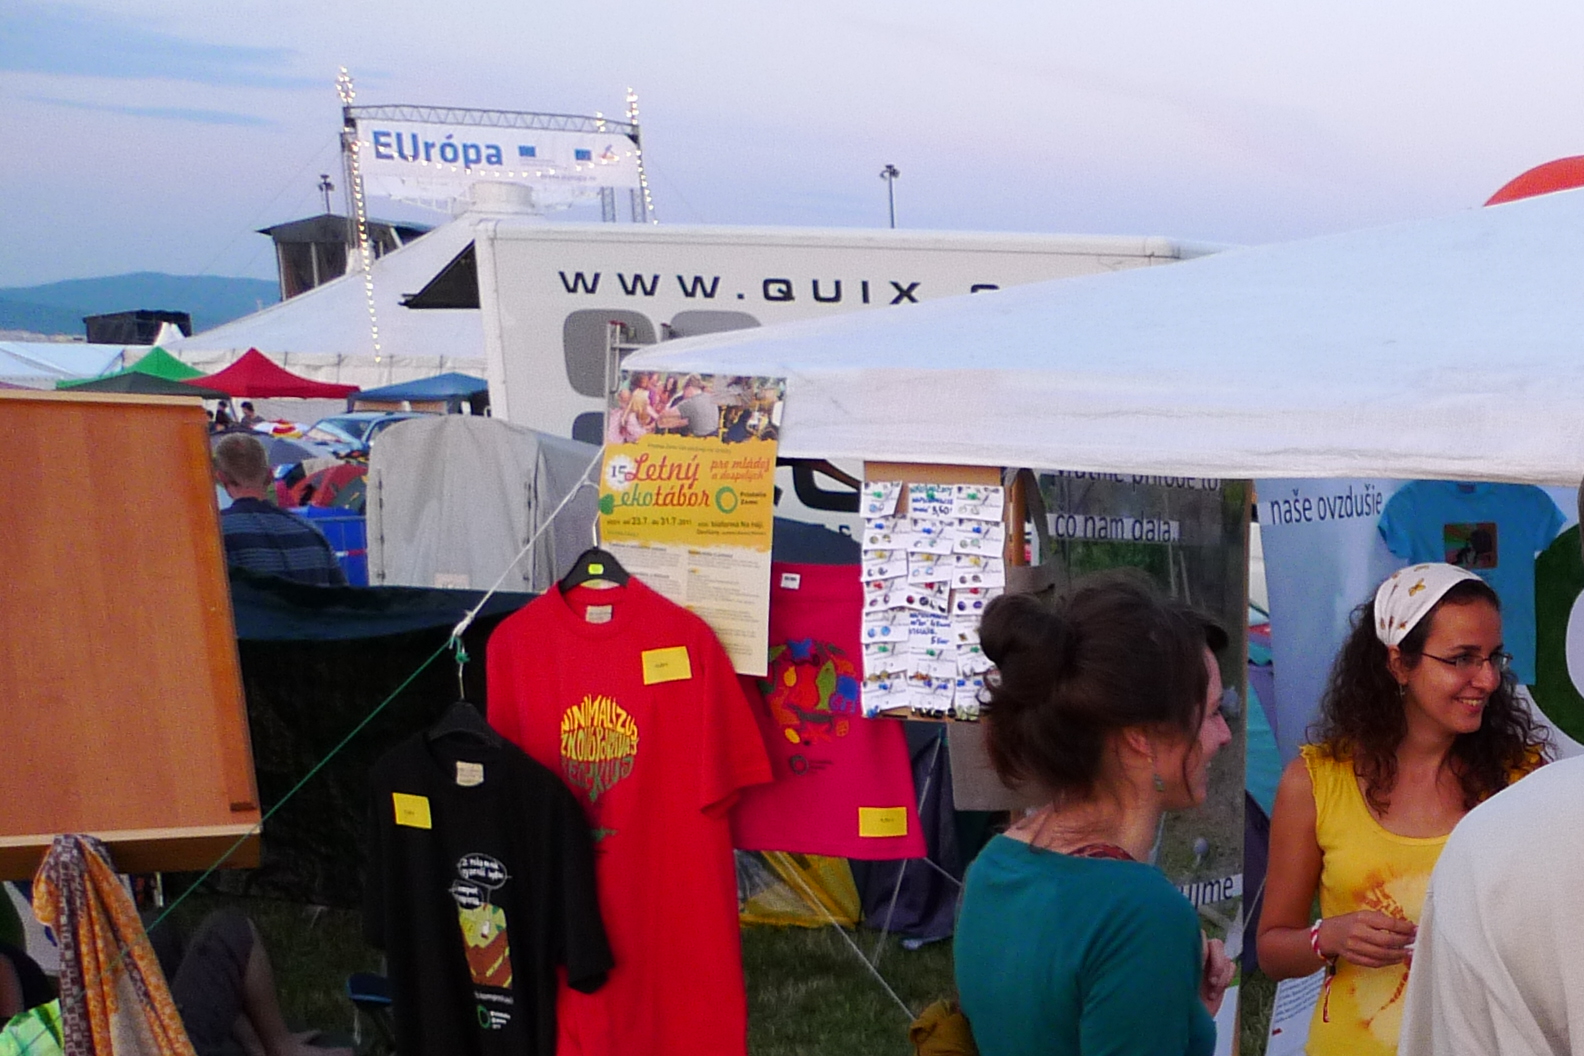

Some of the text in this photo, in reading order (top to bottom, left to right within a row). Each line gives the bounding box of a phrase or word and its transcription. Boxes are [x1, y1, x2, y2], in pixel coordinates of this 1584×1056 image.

[372, 130, 503, 172] EUrópa
[625, 453, 700, 489] Letný
[1271, 484, 1383, 525] naše ovzdušie
